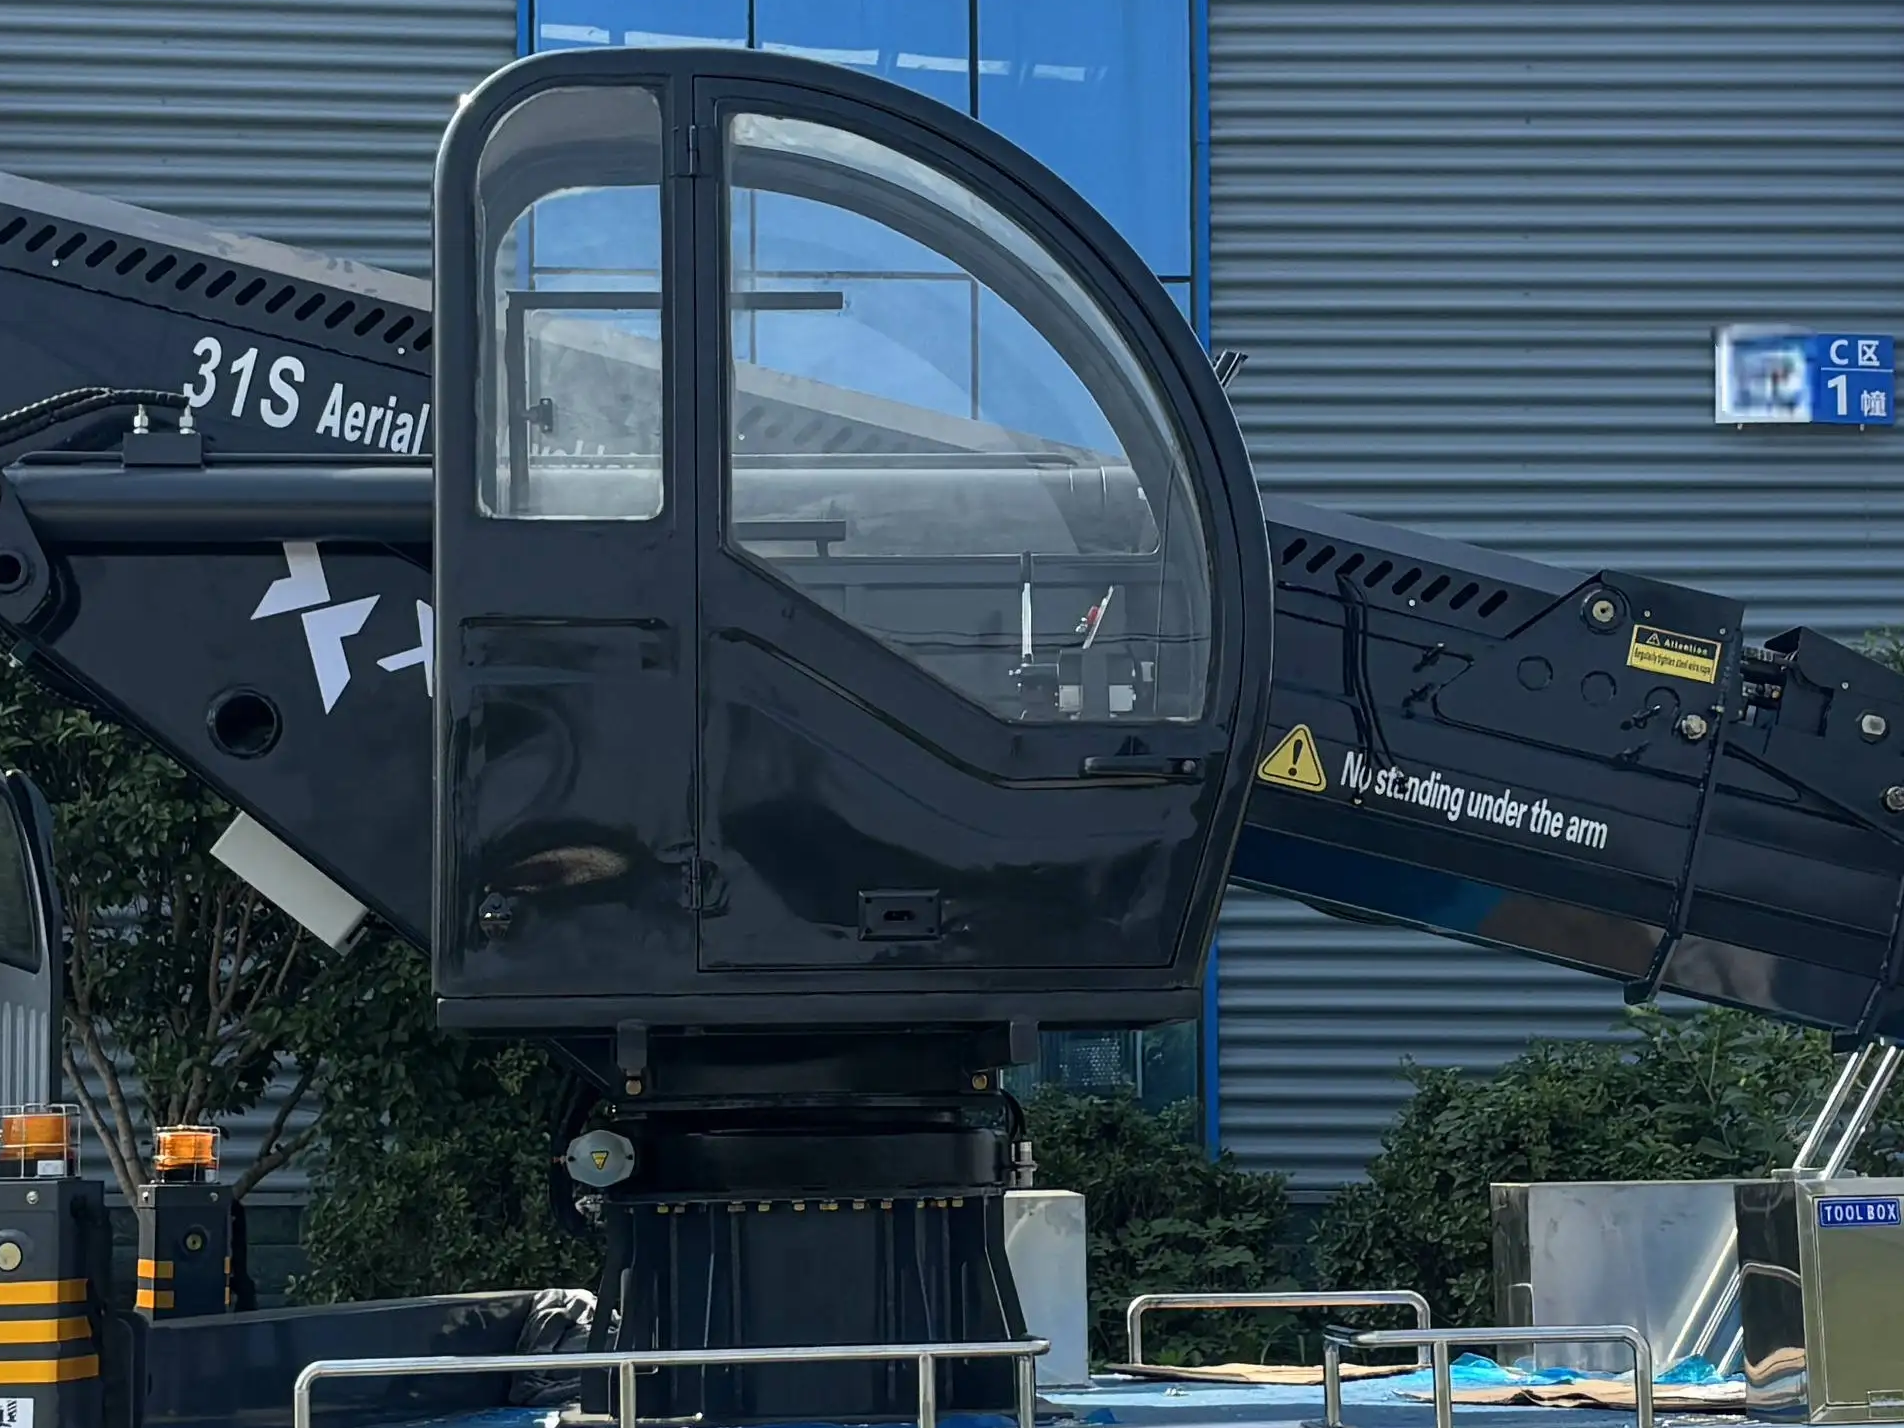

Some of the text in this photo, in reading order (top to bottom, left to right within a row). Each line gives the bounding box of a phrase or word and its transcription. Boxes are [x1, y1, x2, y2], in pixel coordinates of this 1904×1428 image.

[183, 336, 430, 455] 31S Aerial
[1664, 638, 1708, 655] Attention
[1340, 750, 1372, 792] No
[1467, 788, 1529, 829] under
[1530, 799, 1563, 838] the
[1565, 816, 1608, 850] arm
[1824, 1203, 1897, 1221] TOOL BOX
